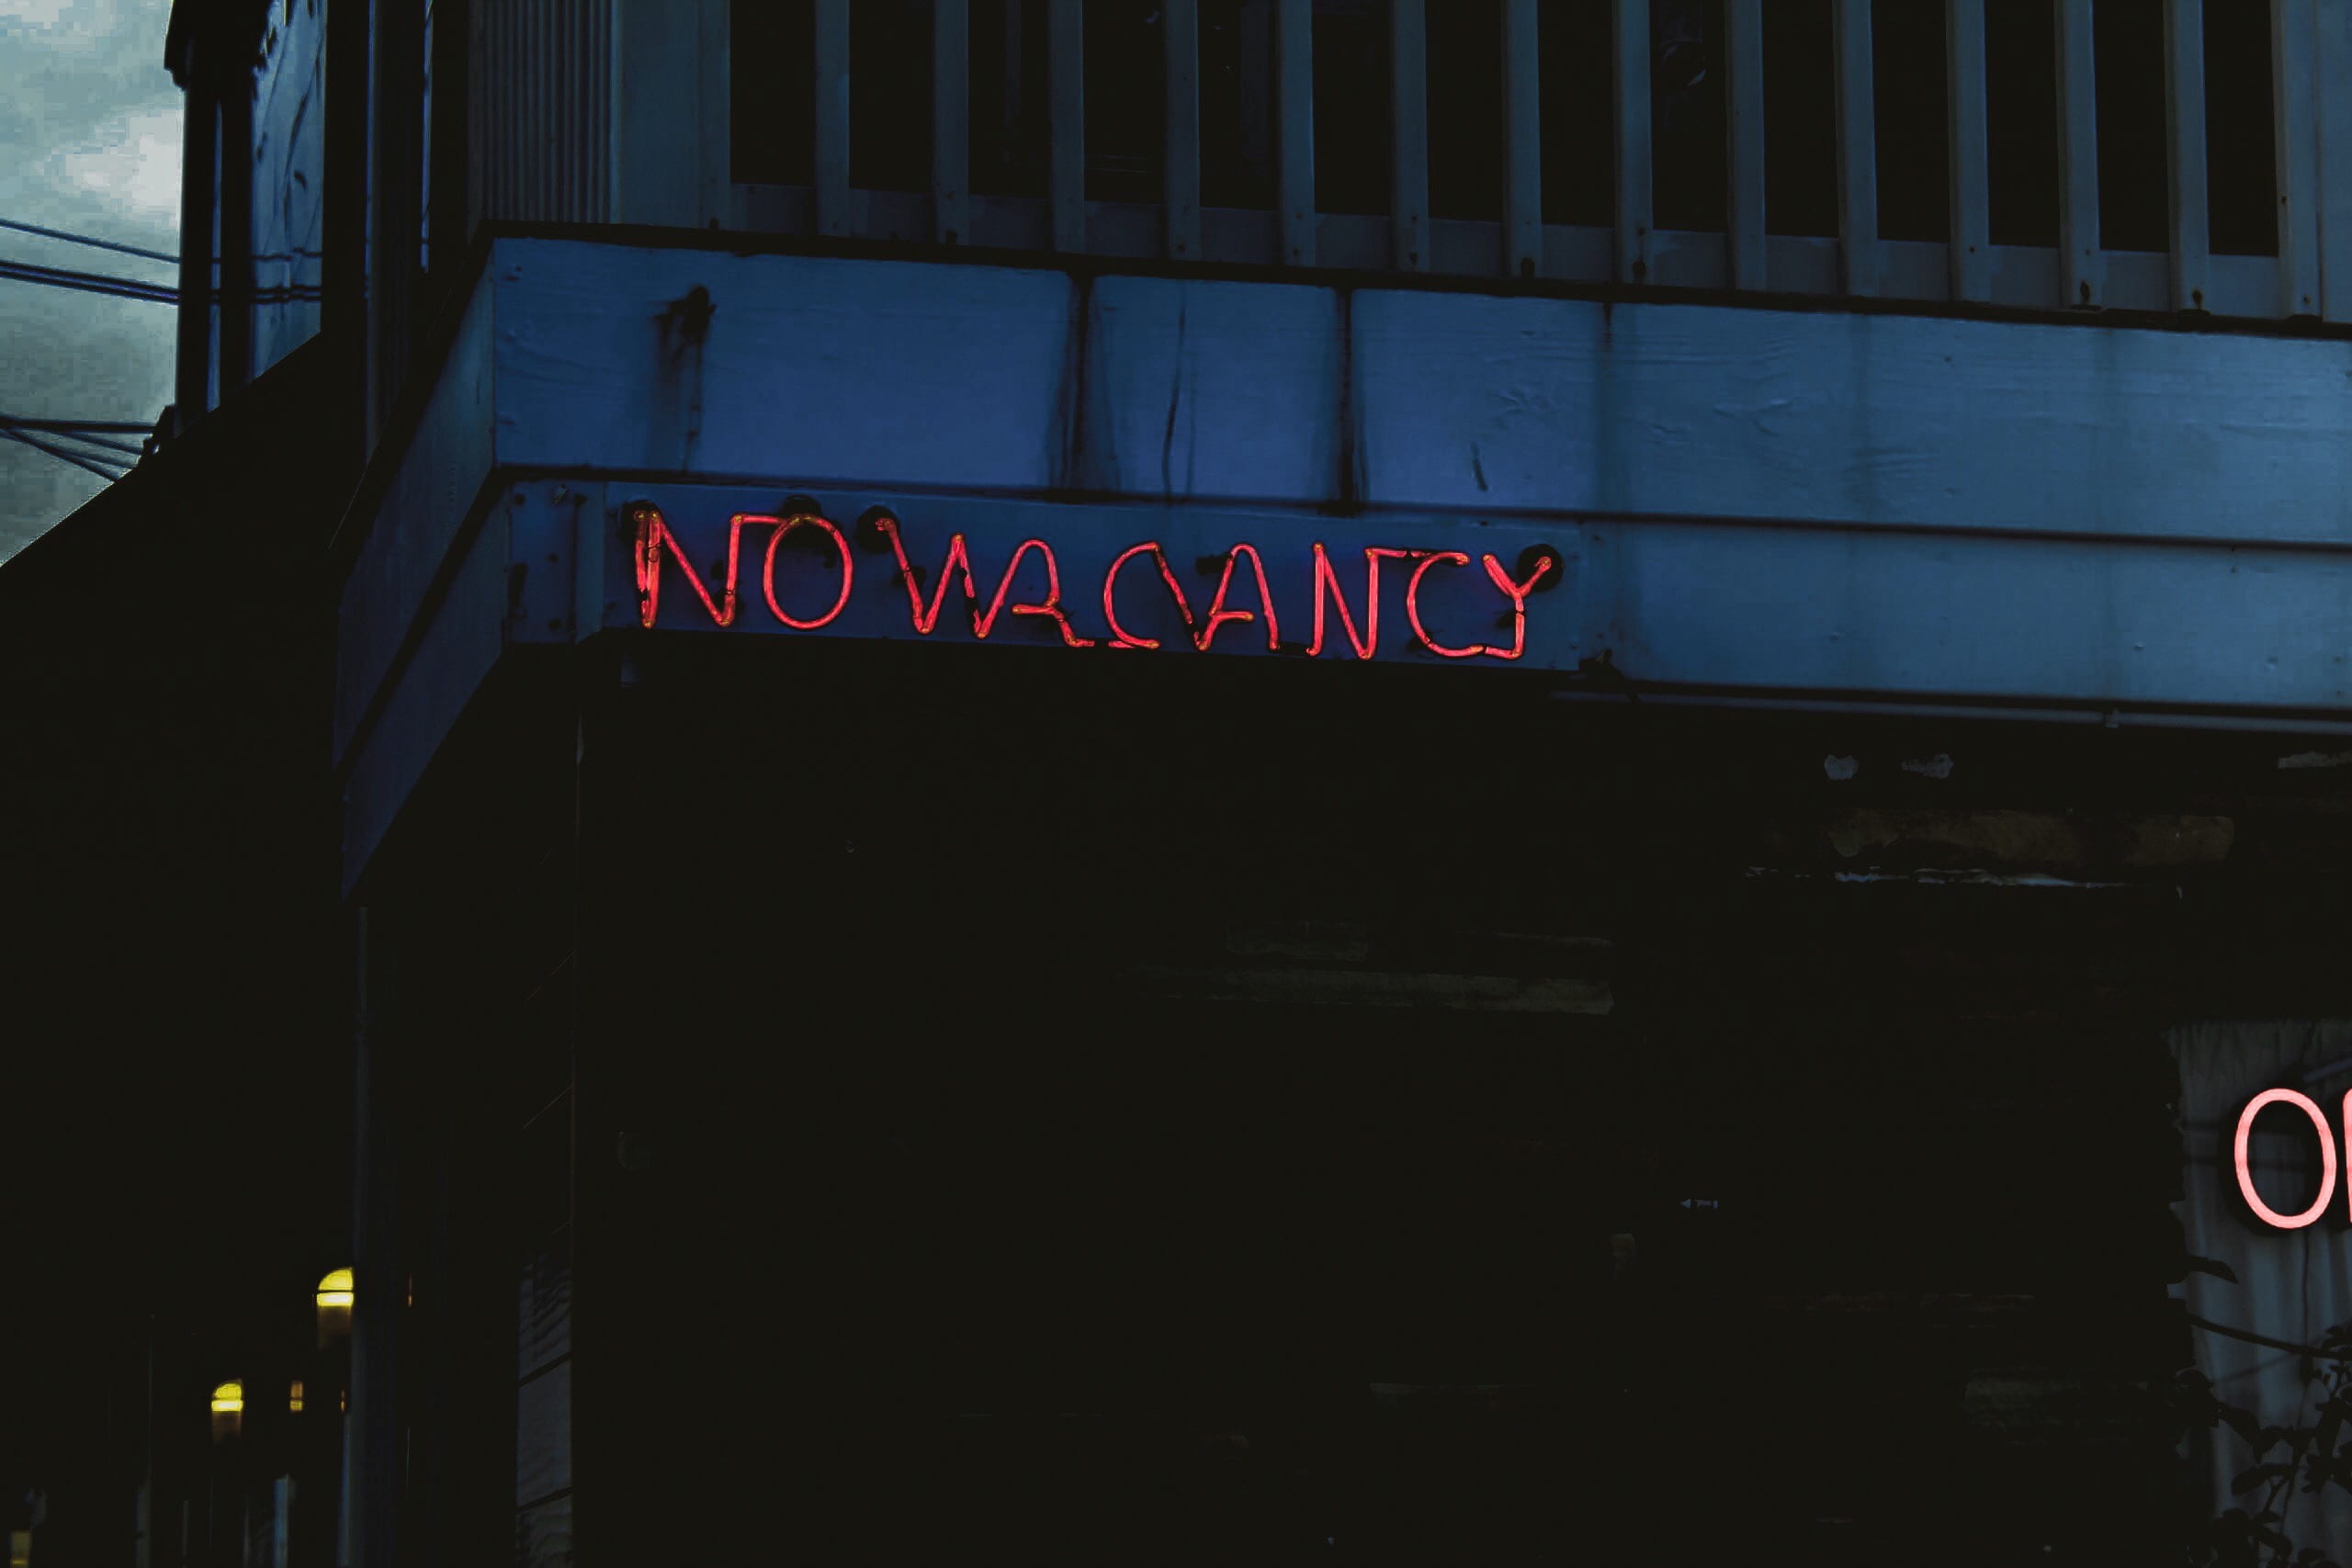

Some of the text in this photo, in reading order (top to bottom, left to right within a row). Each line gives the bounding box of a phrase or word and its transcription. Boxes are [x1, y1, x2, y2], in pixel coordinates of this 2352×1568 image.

[635, 512, 1552, 660] NO VACANCY
[2233, 1088, 2352, 1229] O
